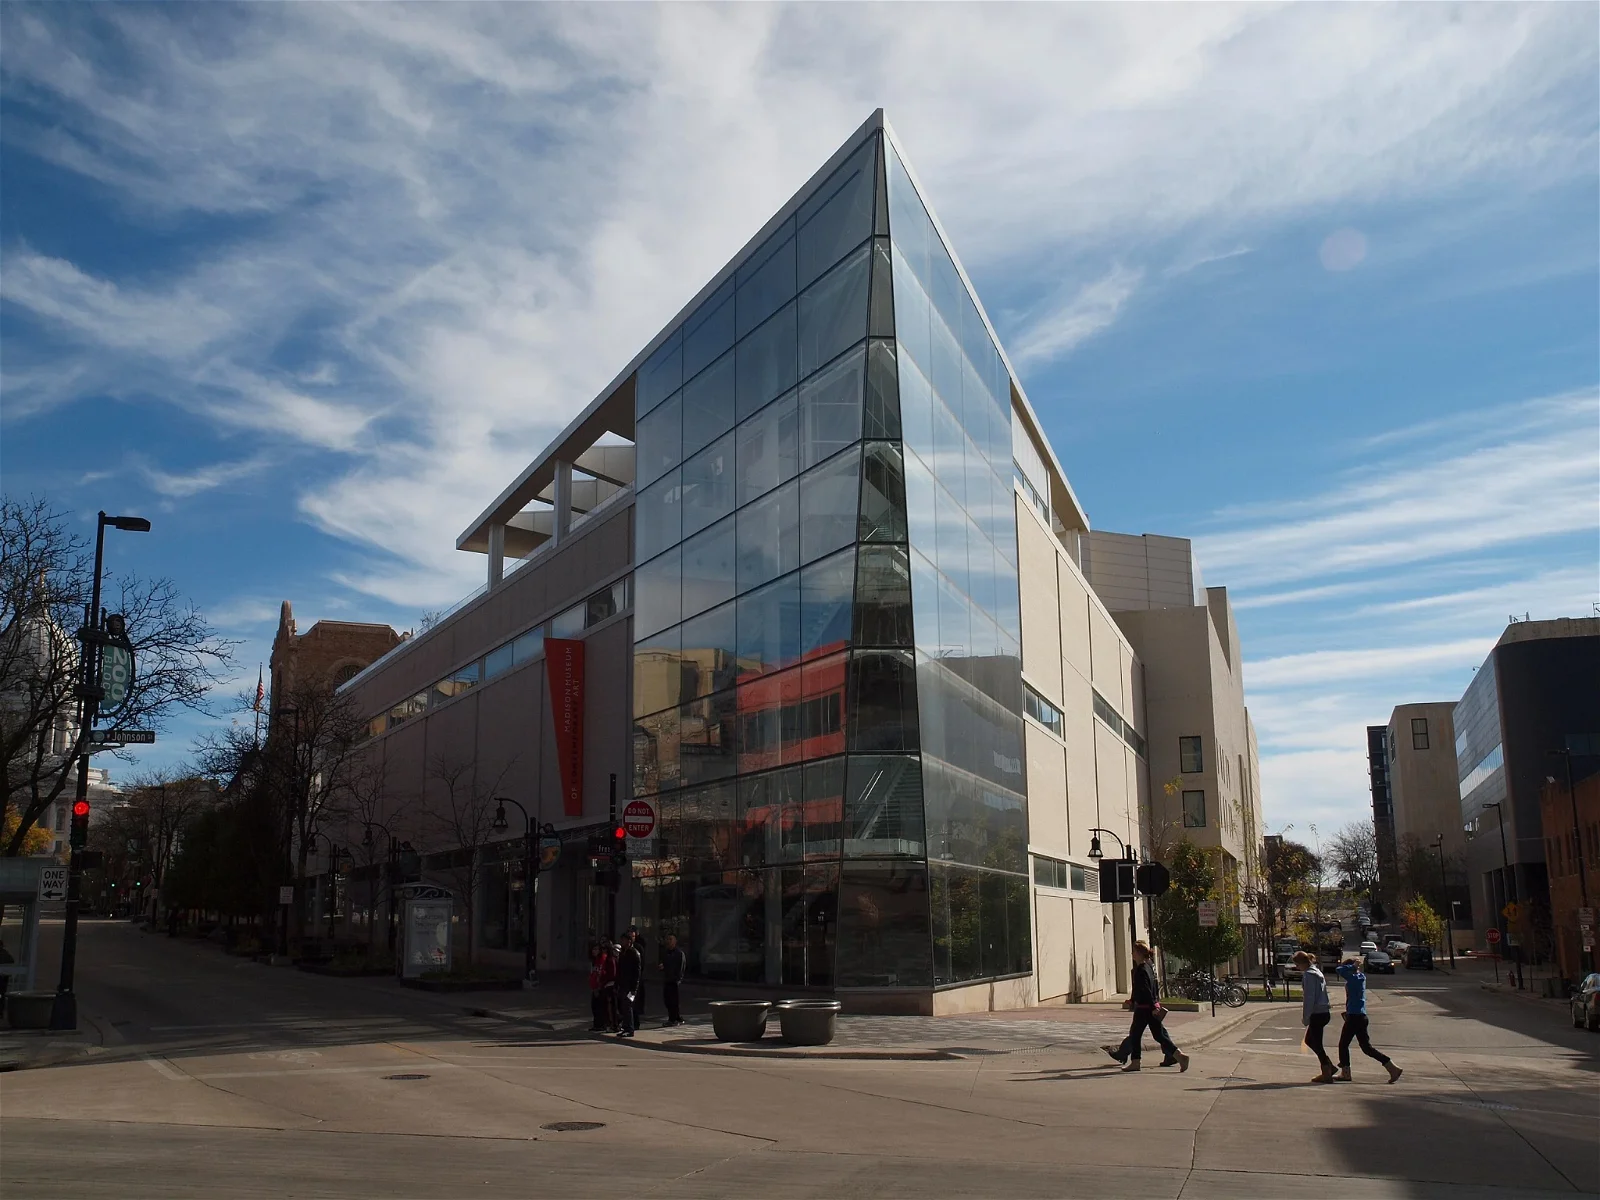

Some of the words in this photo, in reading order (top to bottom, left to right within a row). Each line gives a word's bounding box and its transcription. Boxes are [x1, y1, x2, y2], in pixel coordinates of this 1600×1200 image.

[103, 656, 112, 700] BLOCK
[111, 647, 127, 700] 200
[564, 687, 572, 733] MADISON
[111, 732, 146, 742] Johnson
[571, 787, 578, 800] OF
[44, 870, 64, 879] ONE
[43, 880, 64, 888] WAY
